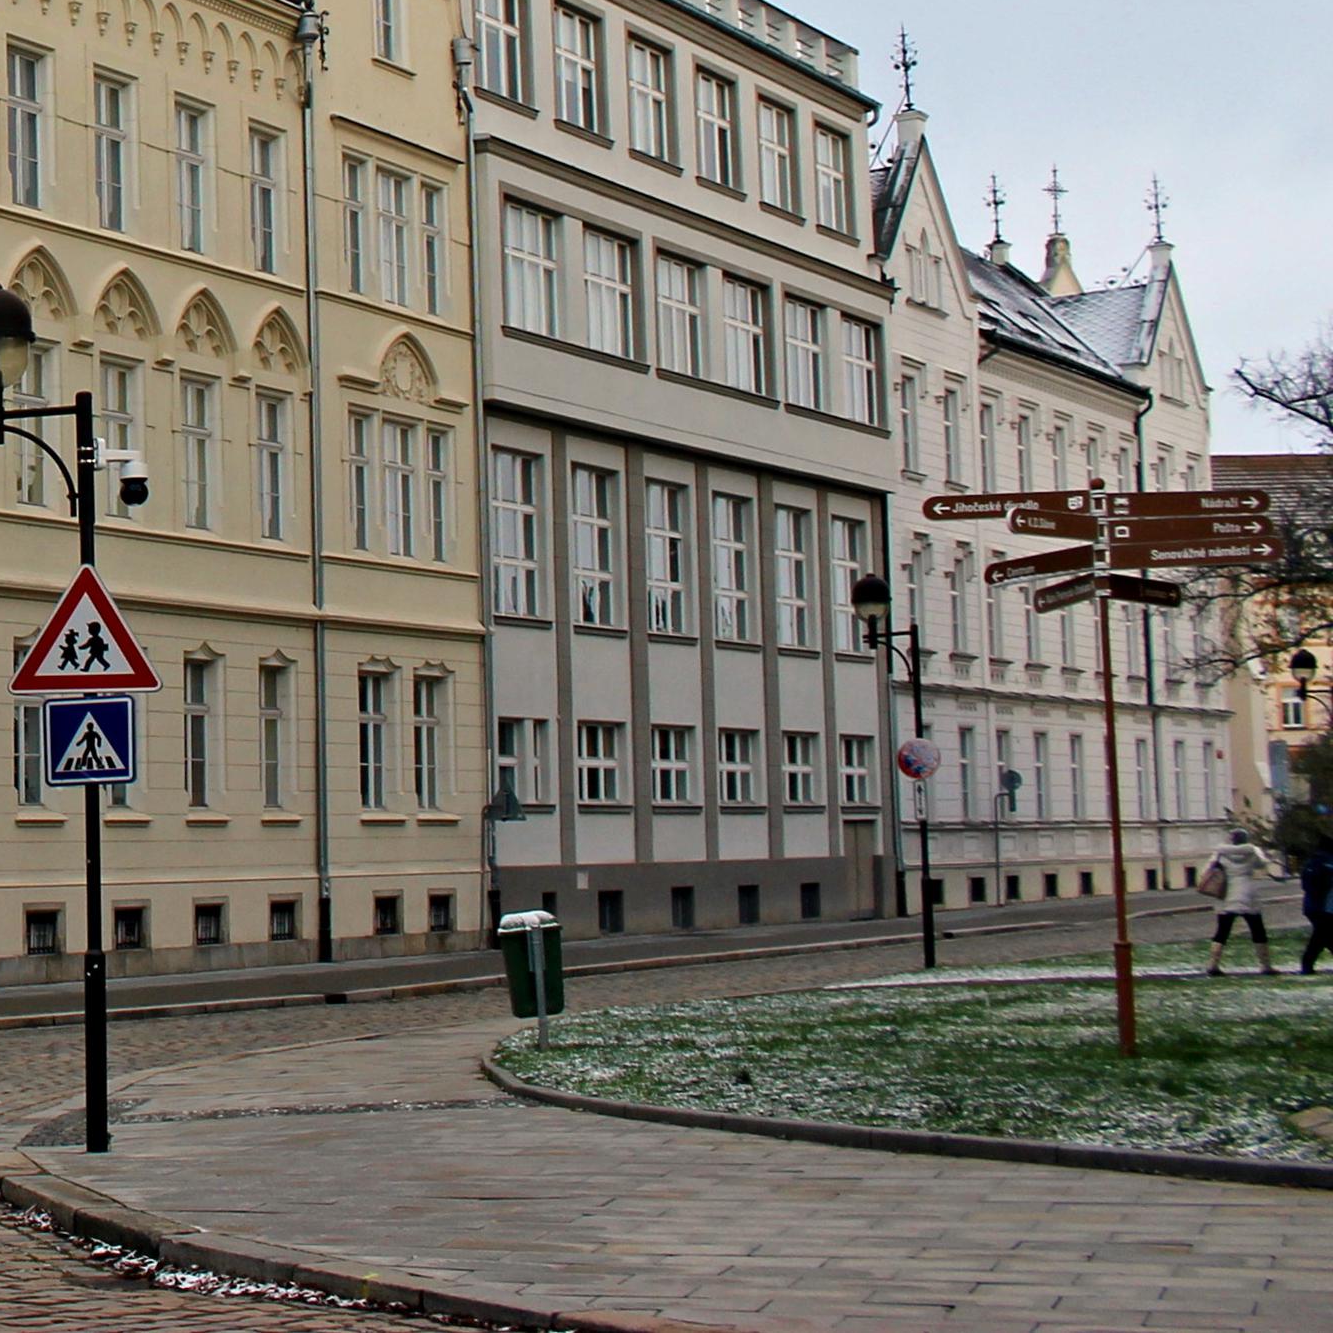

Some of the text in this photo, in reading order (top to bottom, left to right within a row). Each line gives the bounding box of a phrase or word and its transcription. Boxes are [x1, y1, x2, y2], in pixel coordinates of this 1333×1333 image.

[952, 501, 1002, 513] Jihočeské
[1200, 497, 1239, 509] Nádraží
[1213, 522, 1241, 534] Pošta
[1150, 544, 1250, 561] Senovážné náměstí
